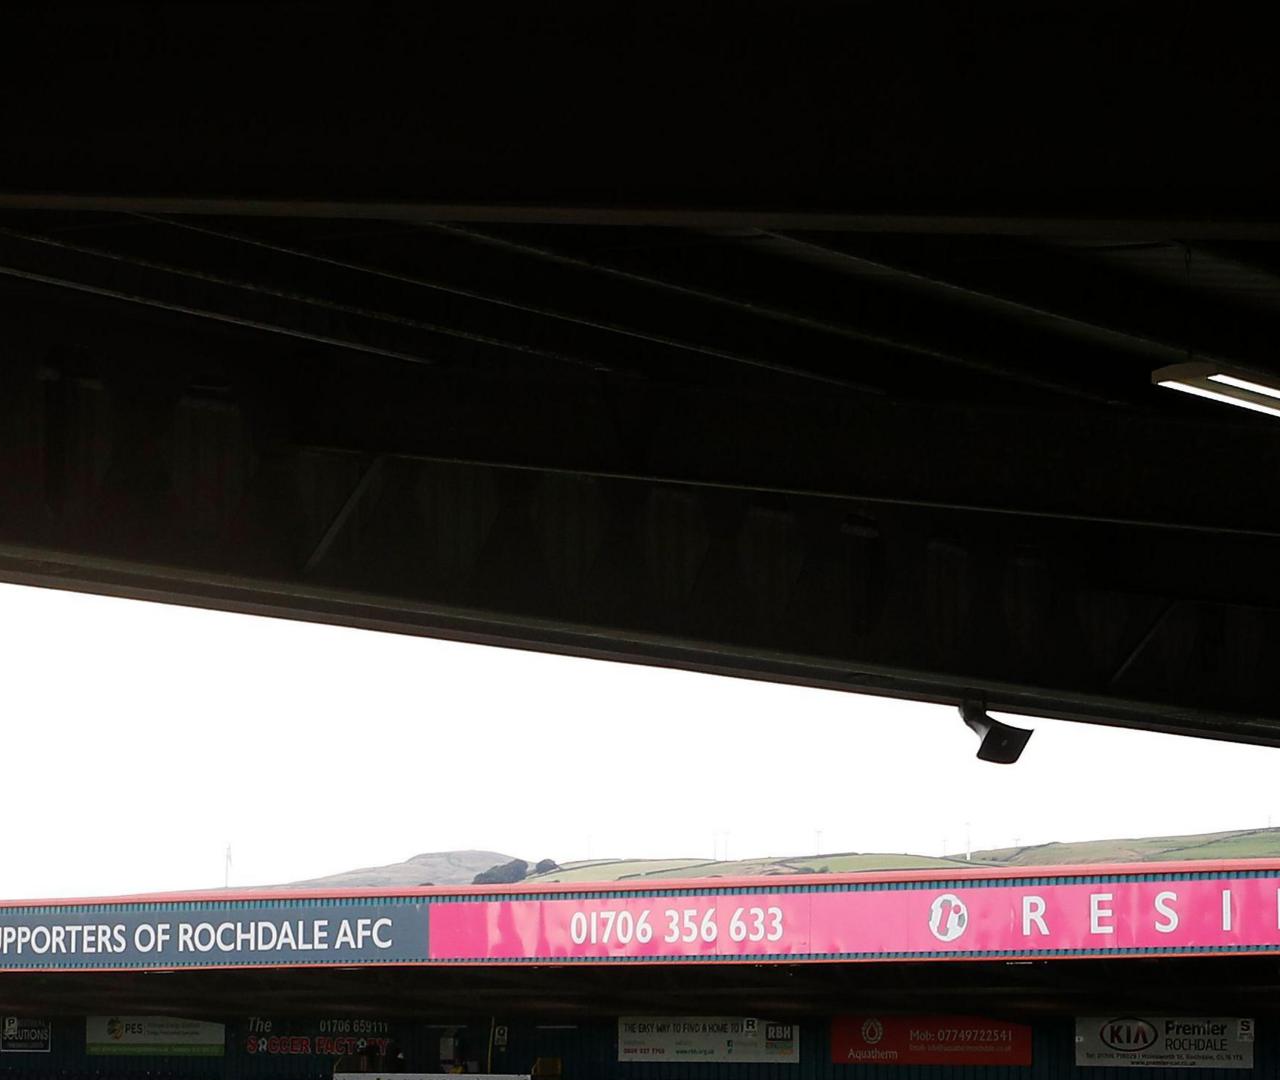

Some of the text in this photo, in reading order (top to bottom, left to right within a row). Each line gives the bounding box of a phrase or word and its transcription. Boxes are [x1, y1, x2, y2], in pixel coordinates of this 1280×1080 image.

[134, 921, 171, 952] OF
[177, 918, 329, 952] ROCHDALE
[334, 916, 393, 950] AFC
[570, 907, 784, 947] 01706 356 633
[125, 1023, 143, 1034] PES
[247, 1016, 273, 1033] The
[319, 1018, 351, 1032] 01706
[746, 1019, 756, 1030] R
[767, 1024, 791, 1039] RBH
[1165, 1020, 1227, 1036] Premier
[1240, 1020, 1251, 1032] S
[909, 1029, 1012, 1042] Mob: 07749722541
[1110, 1025, 1148, 1044] KIA
[1165, 1038, 1228, 1051] ROCHDALE
[847, 1048, 898, 1062] Aquatherm
